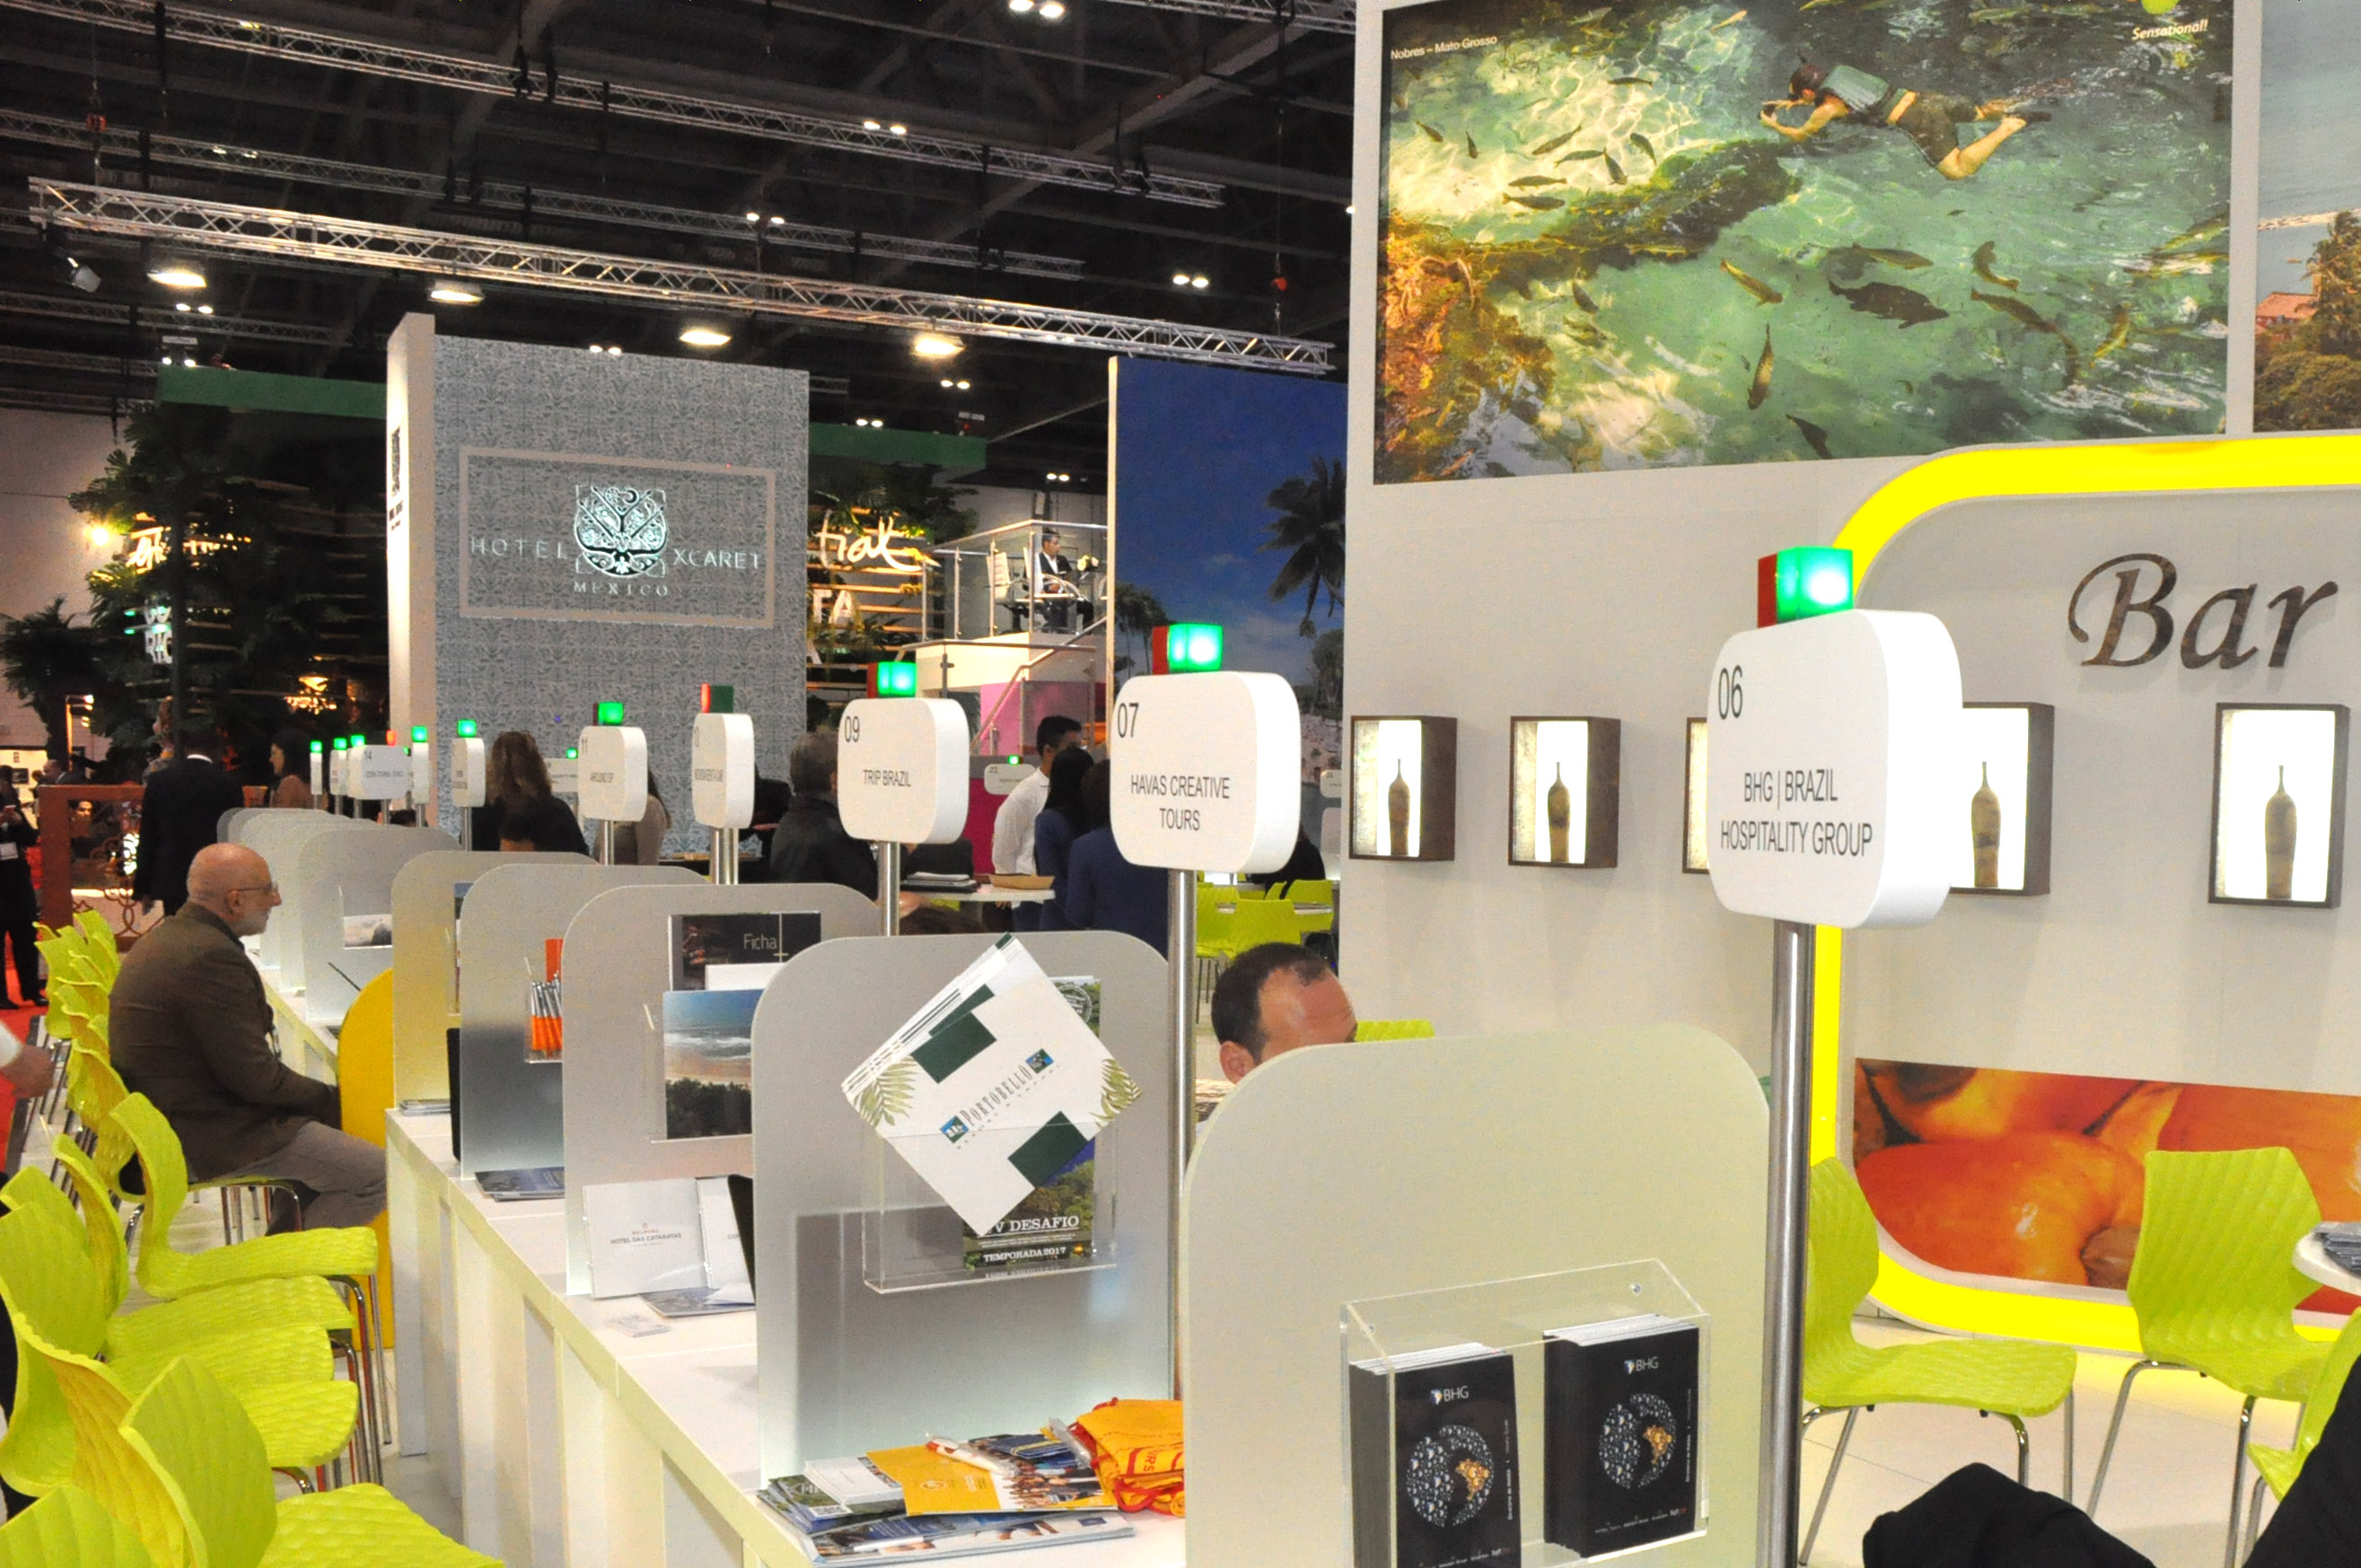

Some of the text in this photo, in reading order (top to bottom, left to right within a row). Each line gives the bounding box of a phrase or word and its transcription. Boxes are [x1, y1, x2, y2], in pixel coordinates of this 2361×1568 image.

[2131, 18, 2209, 41] Sensational!
[1391, 47, 1426, 60] Nobres
[1435, 41, 1460, 54] Mato
[1461, 36, 1497, 48] Grosso
[470, 538, 761, 571] HOTEL XCARET
[574, 580, 669, 598] MEXICO
[2067, 552, 2339, 670] Bar
[1717, 664, 1743, 721] 06
[844, 715, 860, 743] 09
[1117, 702, 1139, 739] 07
[863, 769, 912, 788] TRIP BRAZIL
[1130, 774, 1231, 800] HAVAS CREATIVE
[1744, 771, 1773, 802] BHG
[1784, 768, 1839, 802] BRAZIL
[1159, 808, 1201, 832] TOURS
[1721, 820, 1874, 858] HOSPITALITY GROUP
[743, 933, 777, 950] Ficha
[959, 1064, 1032, 1127] PORTOBELLO
[1010, 1215, 1080, 1232] DESAFIO
[983, 1246, 1066, 1263] TEMPORADA 2017
[1636, 1356, 1659, 1371] BHG
[1444, 1386, 1470, 1402] BHG
